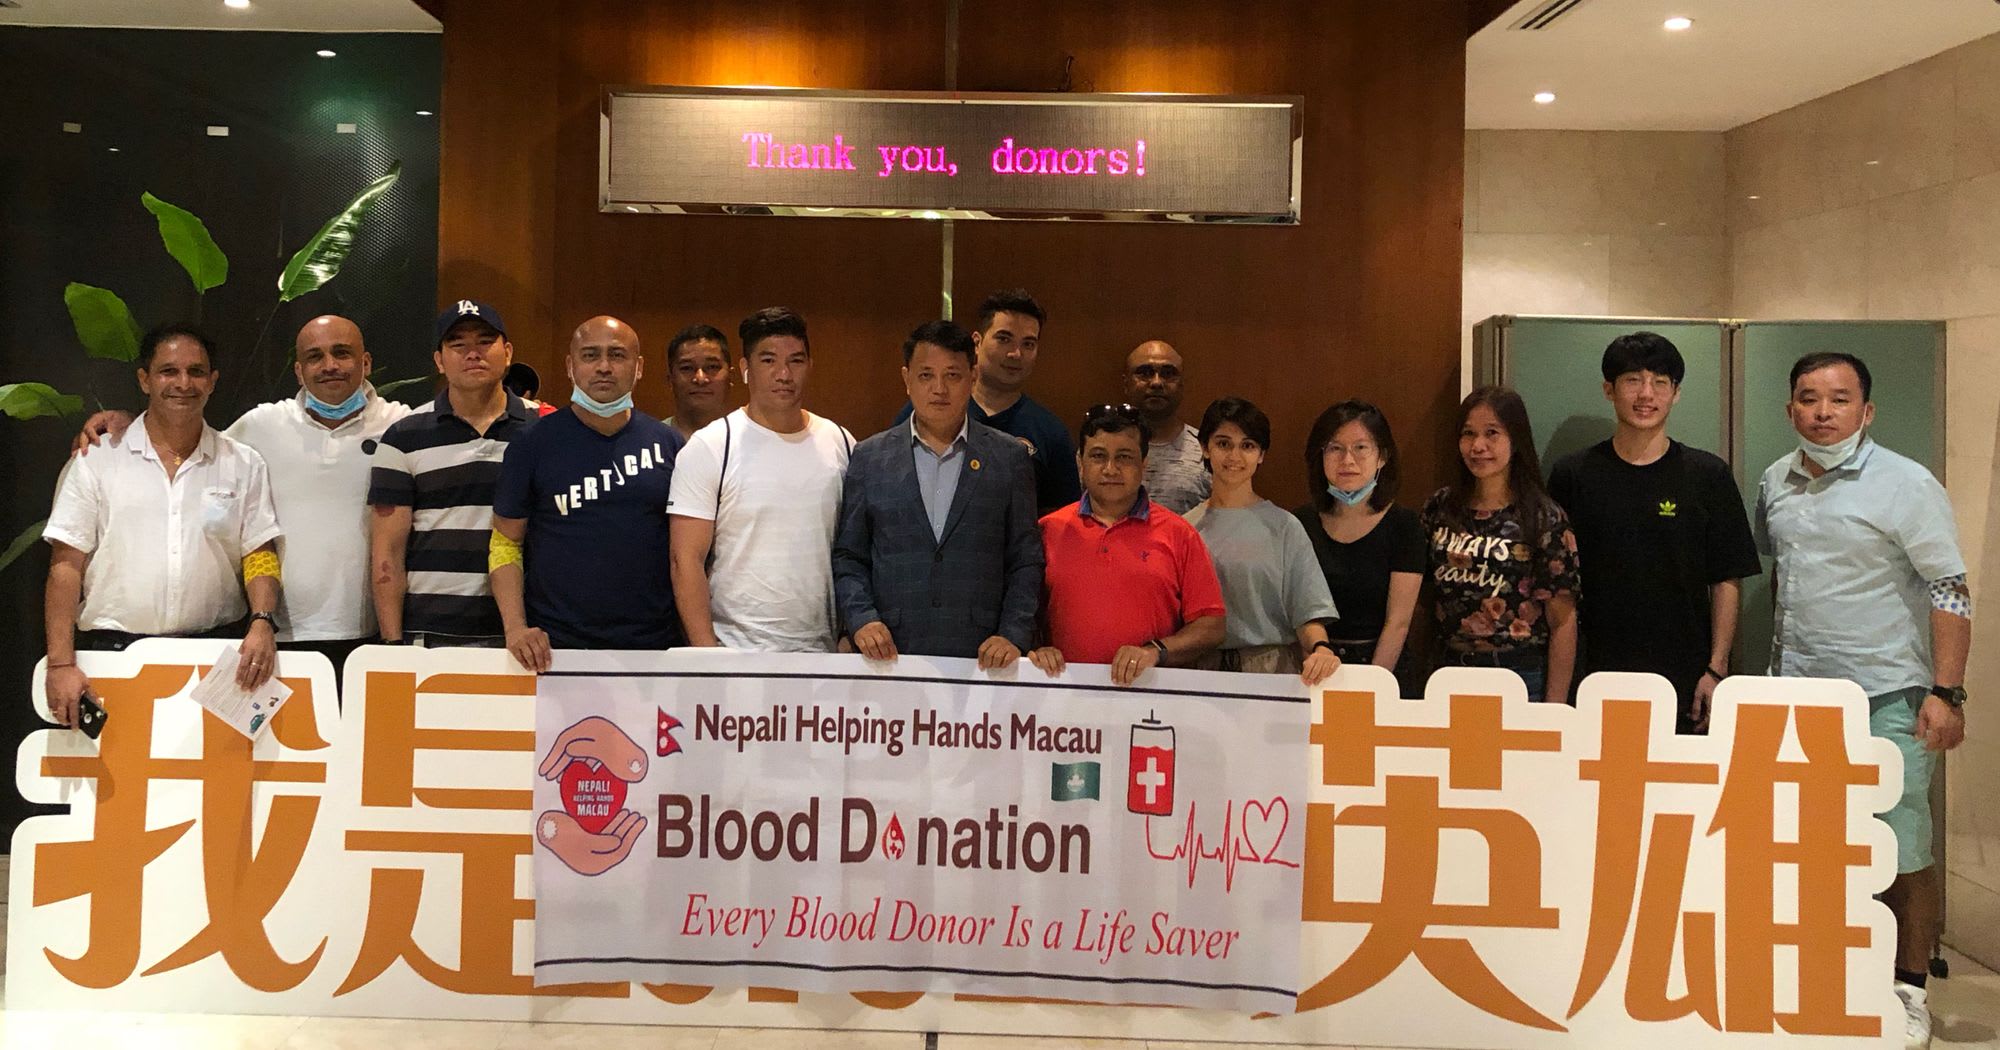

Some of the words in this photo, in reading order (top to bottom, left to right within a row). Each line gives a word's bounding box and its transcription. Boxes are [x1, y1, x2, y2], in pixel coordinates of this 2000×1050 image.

[742, 132, 857, 170] Thank
[878, 146, 957, 177] you,
[991, 137, 1146, 177] donors!
[694, 704, 787, 753] Nepali
[795, 705, 905, 757] Helping
[912, 709, 1002, 750] Hands
[1010, 713, 1102, 754] Macau
[577, 780, 610, 793] NEPALI
[577, 804, 609, 816] MACAU
[657, 794, 820, 862] Blood
[680, 893, 776, 949] Every
[784, 895, 882, 942] Blood
[888, 900, 996, 945] Donor
[1002, 905, 1033, 948] Is
[1043, 919, 1063, 950] a
[1072, 908, 1136, 965] Life
[1145, 911, 1239, 960] Saver
